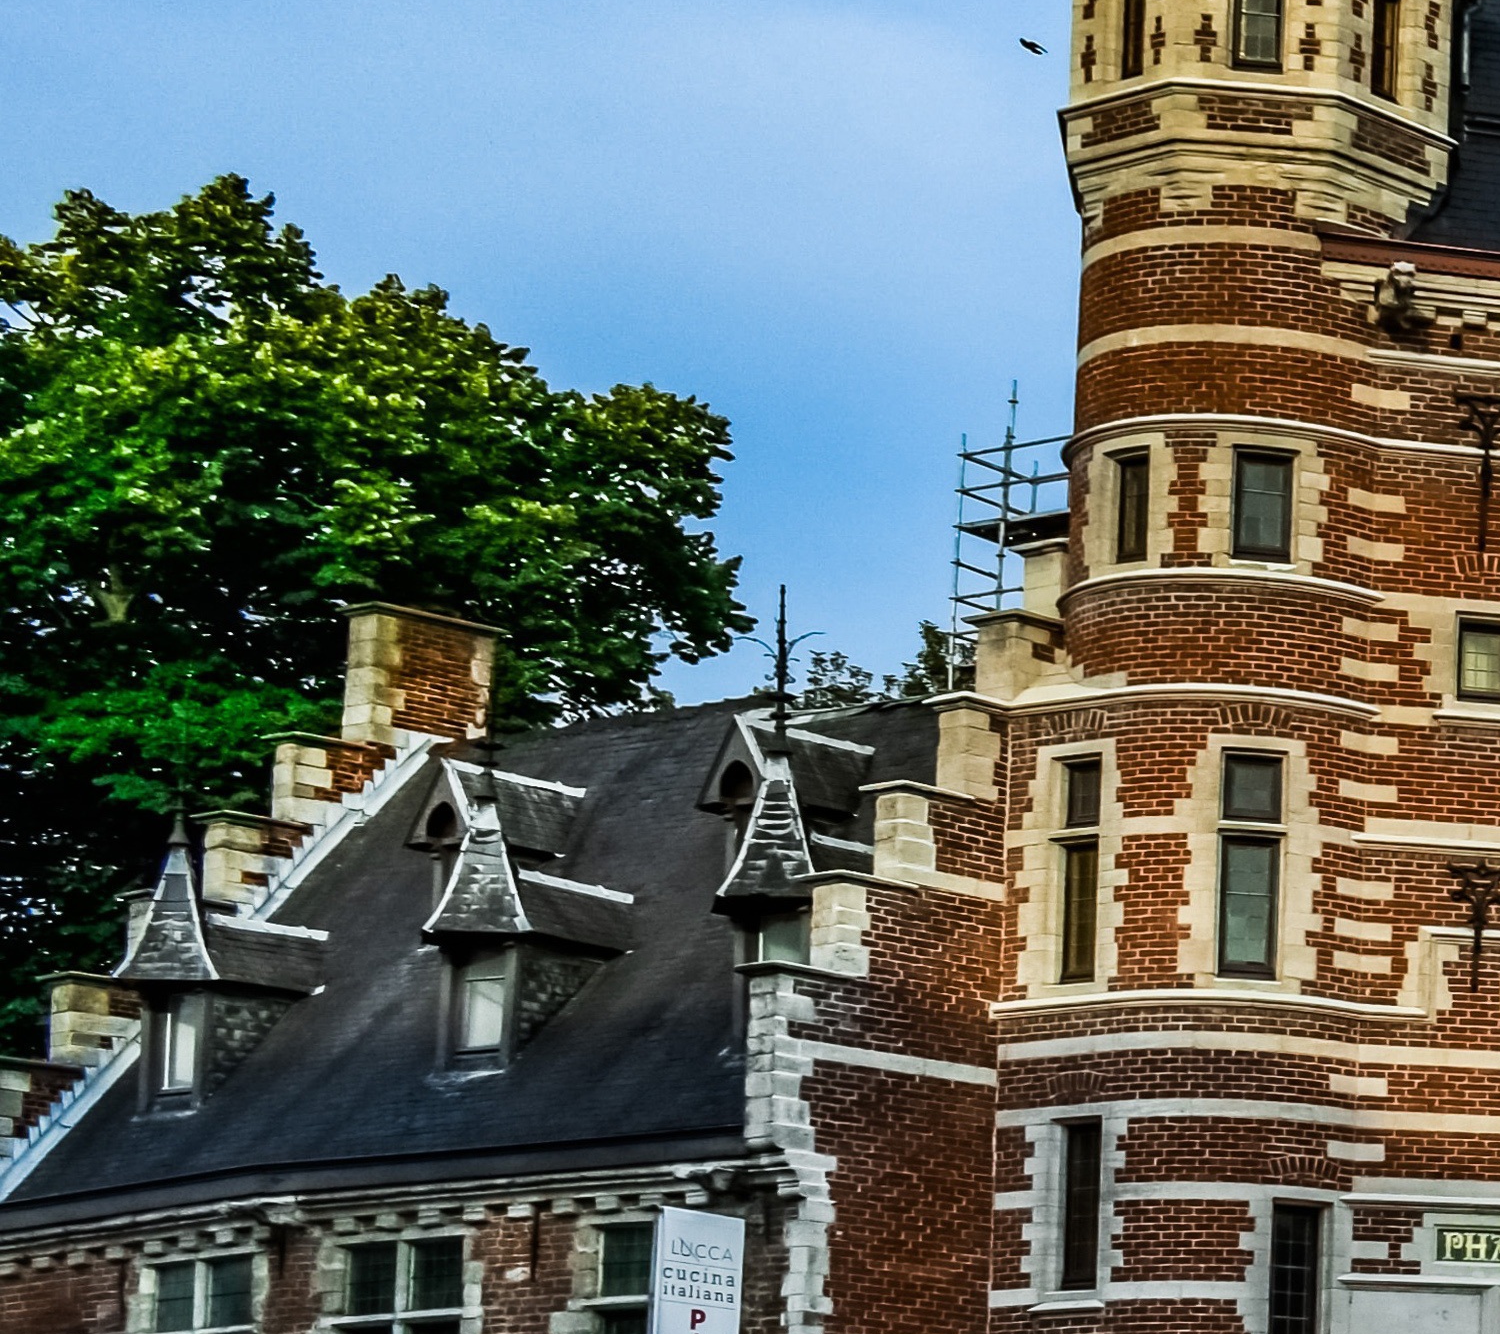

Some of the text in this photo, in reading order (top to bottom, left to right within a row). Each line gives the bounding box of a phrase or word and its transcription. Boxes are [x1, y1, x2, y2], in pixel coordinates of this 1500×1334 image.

[671, 1237, 734, 1263] LUCCA
[662, 1266, 735, 1288] cucina
[662, 1281, 735, 1304] italiana
